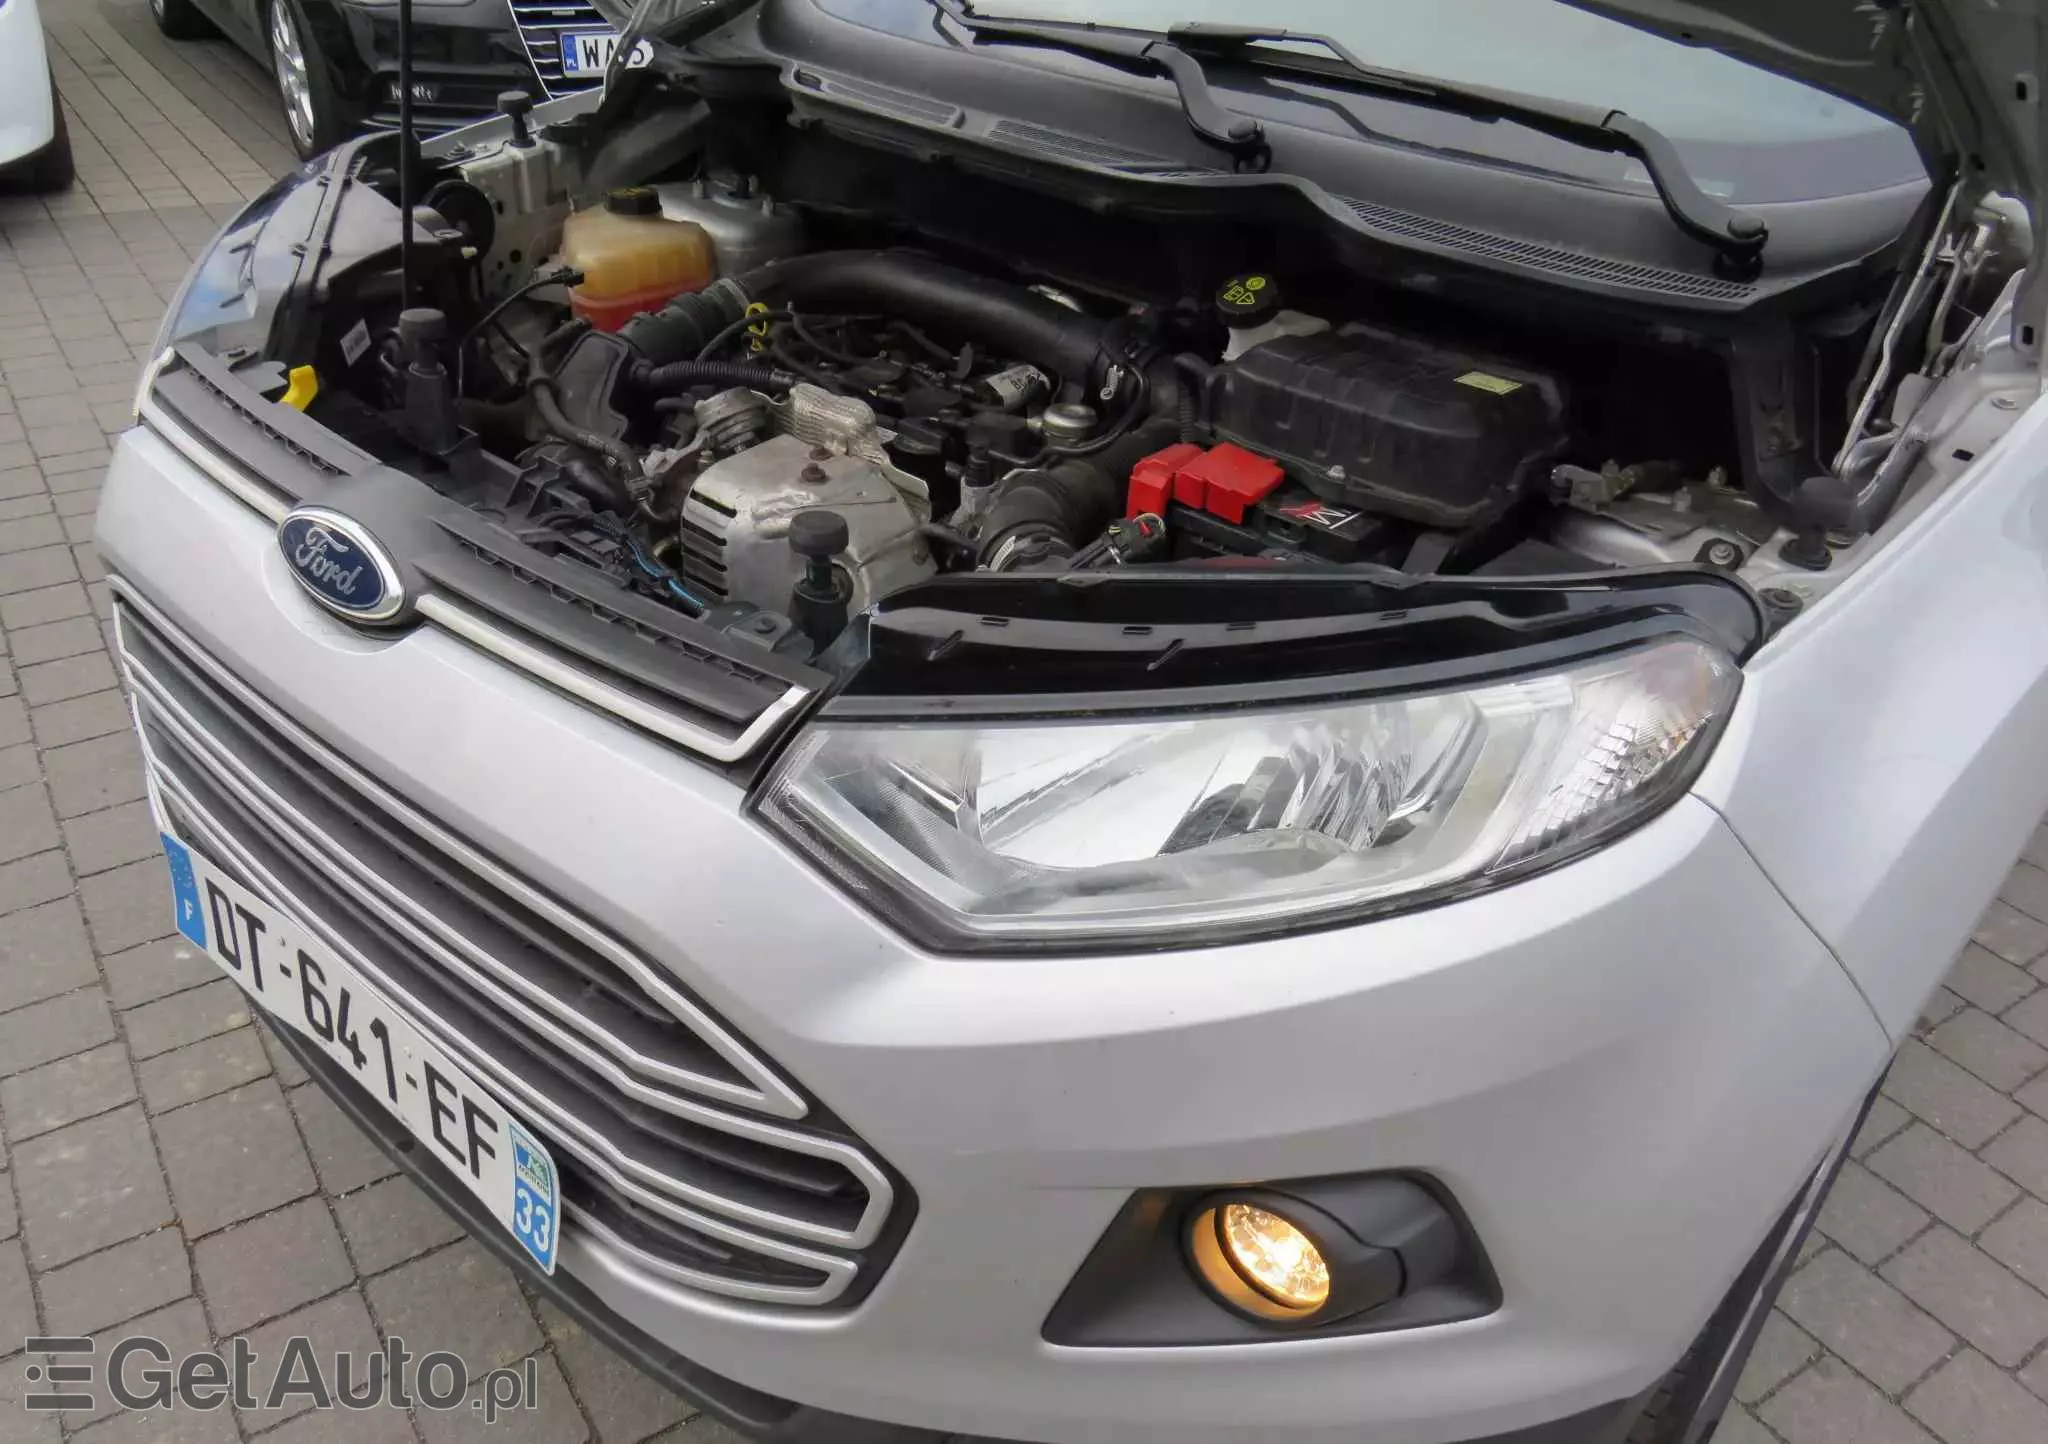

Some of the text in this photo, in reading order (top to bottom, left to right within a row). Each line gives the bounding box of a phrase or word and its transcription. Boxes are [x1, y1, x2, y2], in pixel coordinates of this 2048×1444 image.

[295, 526, 364, 595] Ford
[184, 898, 193, 920] F
[206, 876, 499, 1180] DT-641-EF
[516, 1187, 550, 1253] 33
